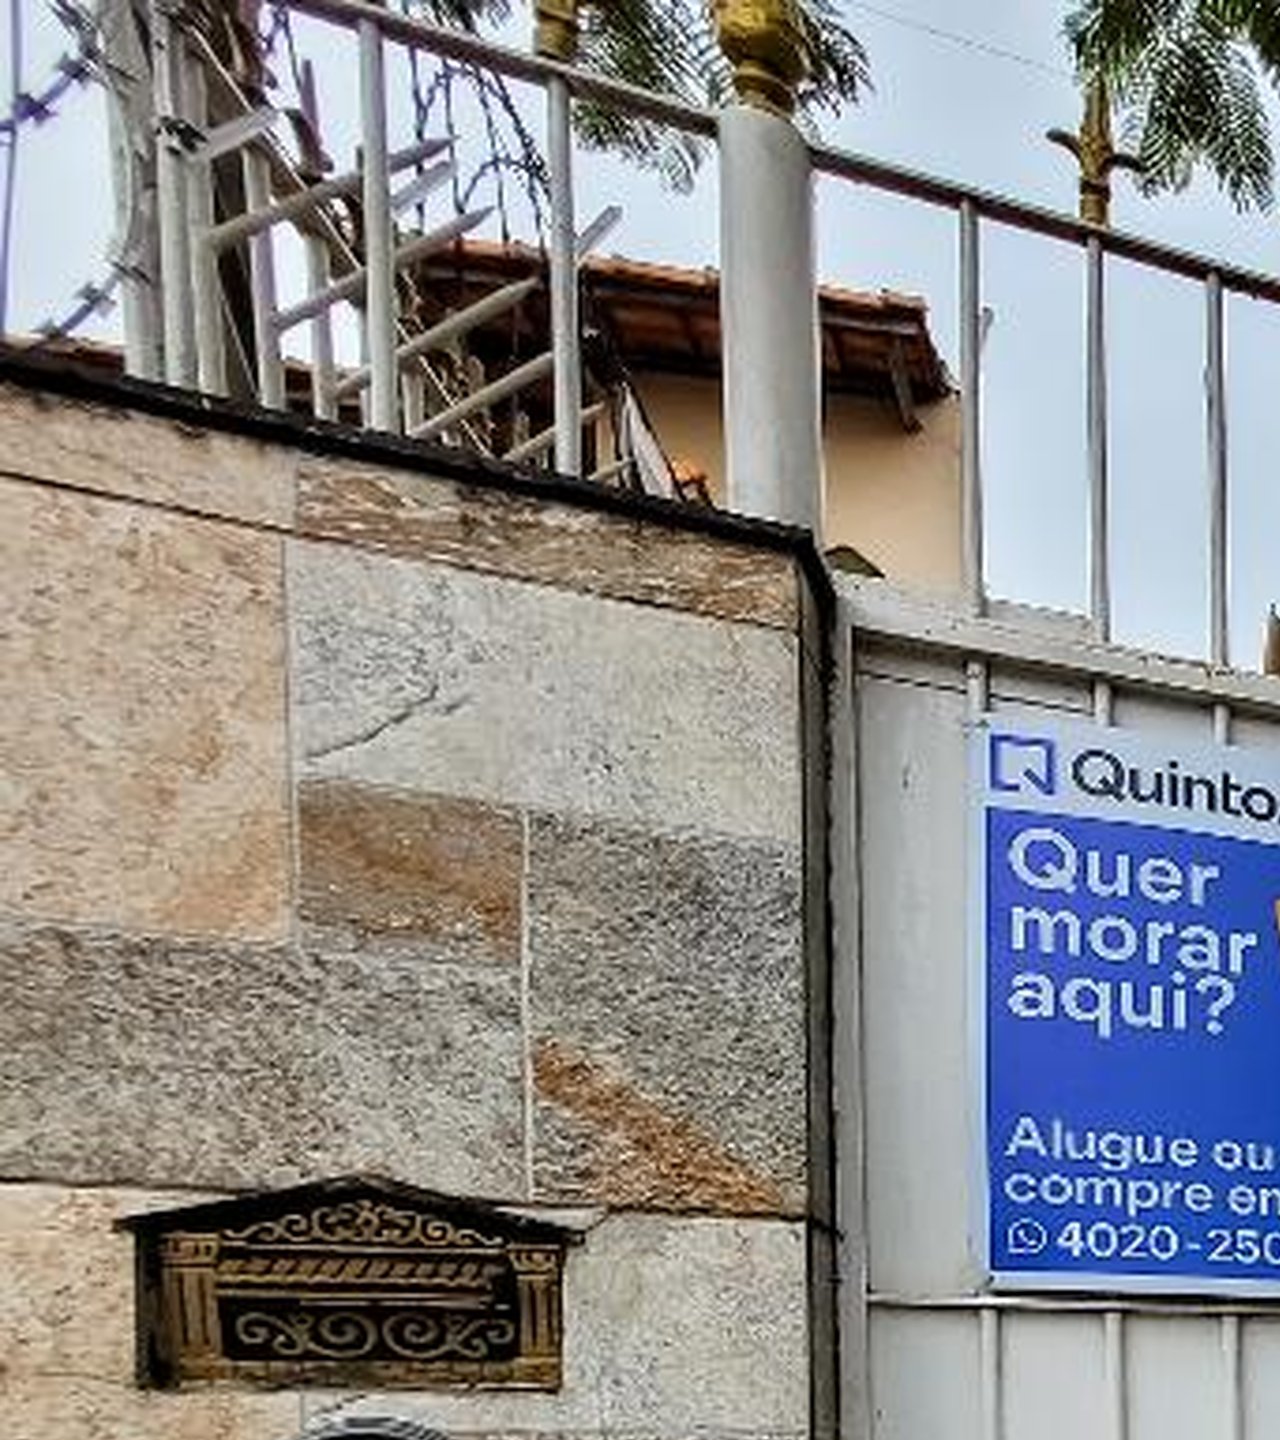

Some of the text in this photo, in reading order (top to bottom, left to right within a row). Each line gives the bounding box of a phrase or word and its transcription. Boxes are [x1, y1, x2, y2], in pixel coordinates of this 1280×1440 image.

[1008, 827, 1220, 906] Quer
[1010, 904, 1258, 974] morar
[1008, 971, 1236, 1039] aqui?
[1004, 1116, 1275, 1171] Alugue ou
[1004, 1171, 1213, 1217] compre
